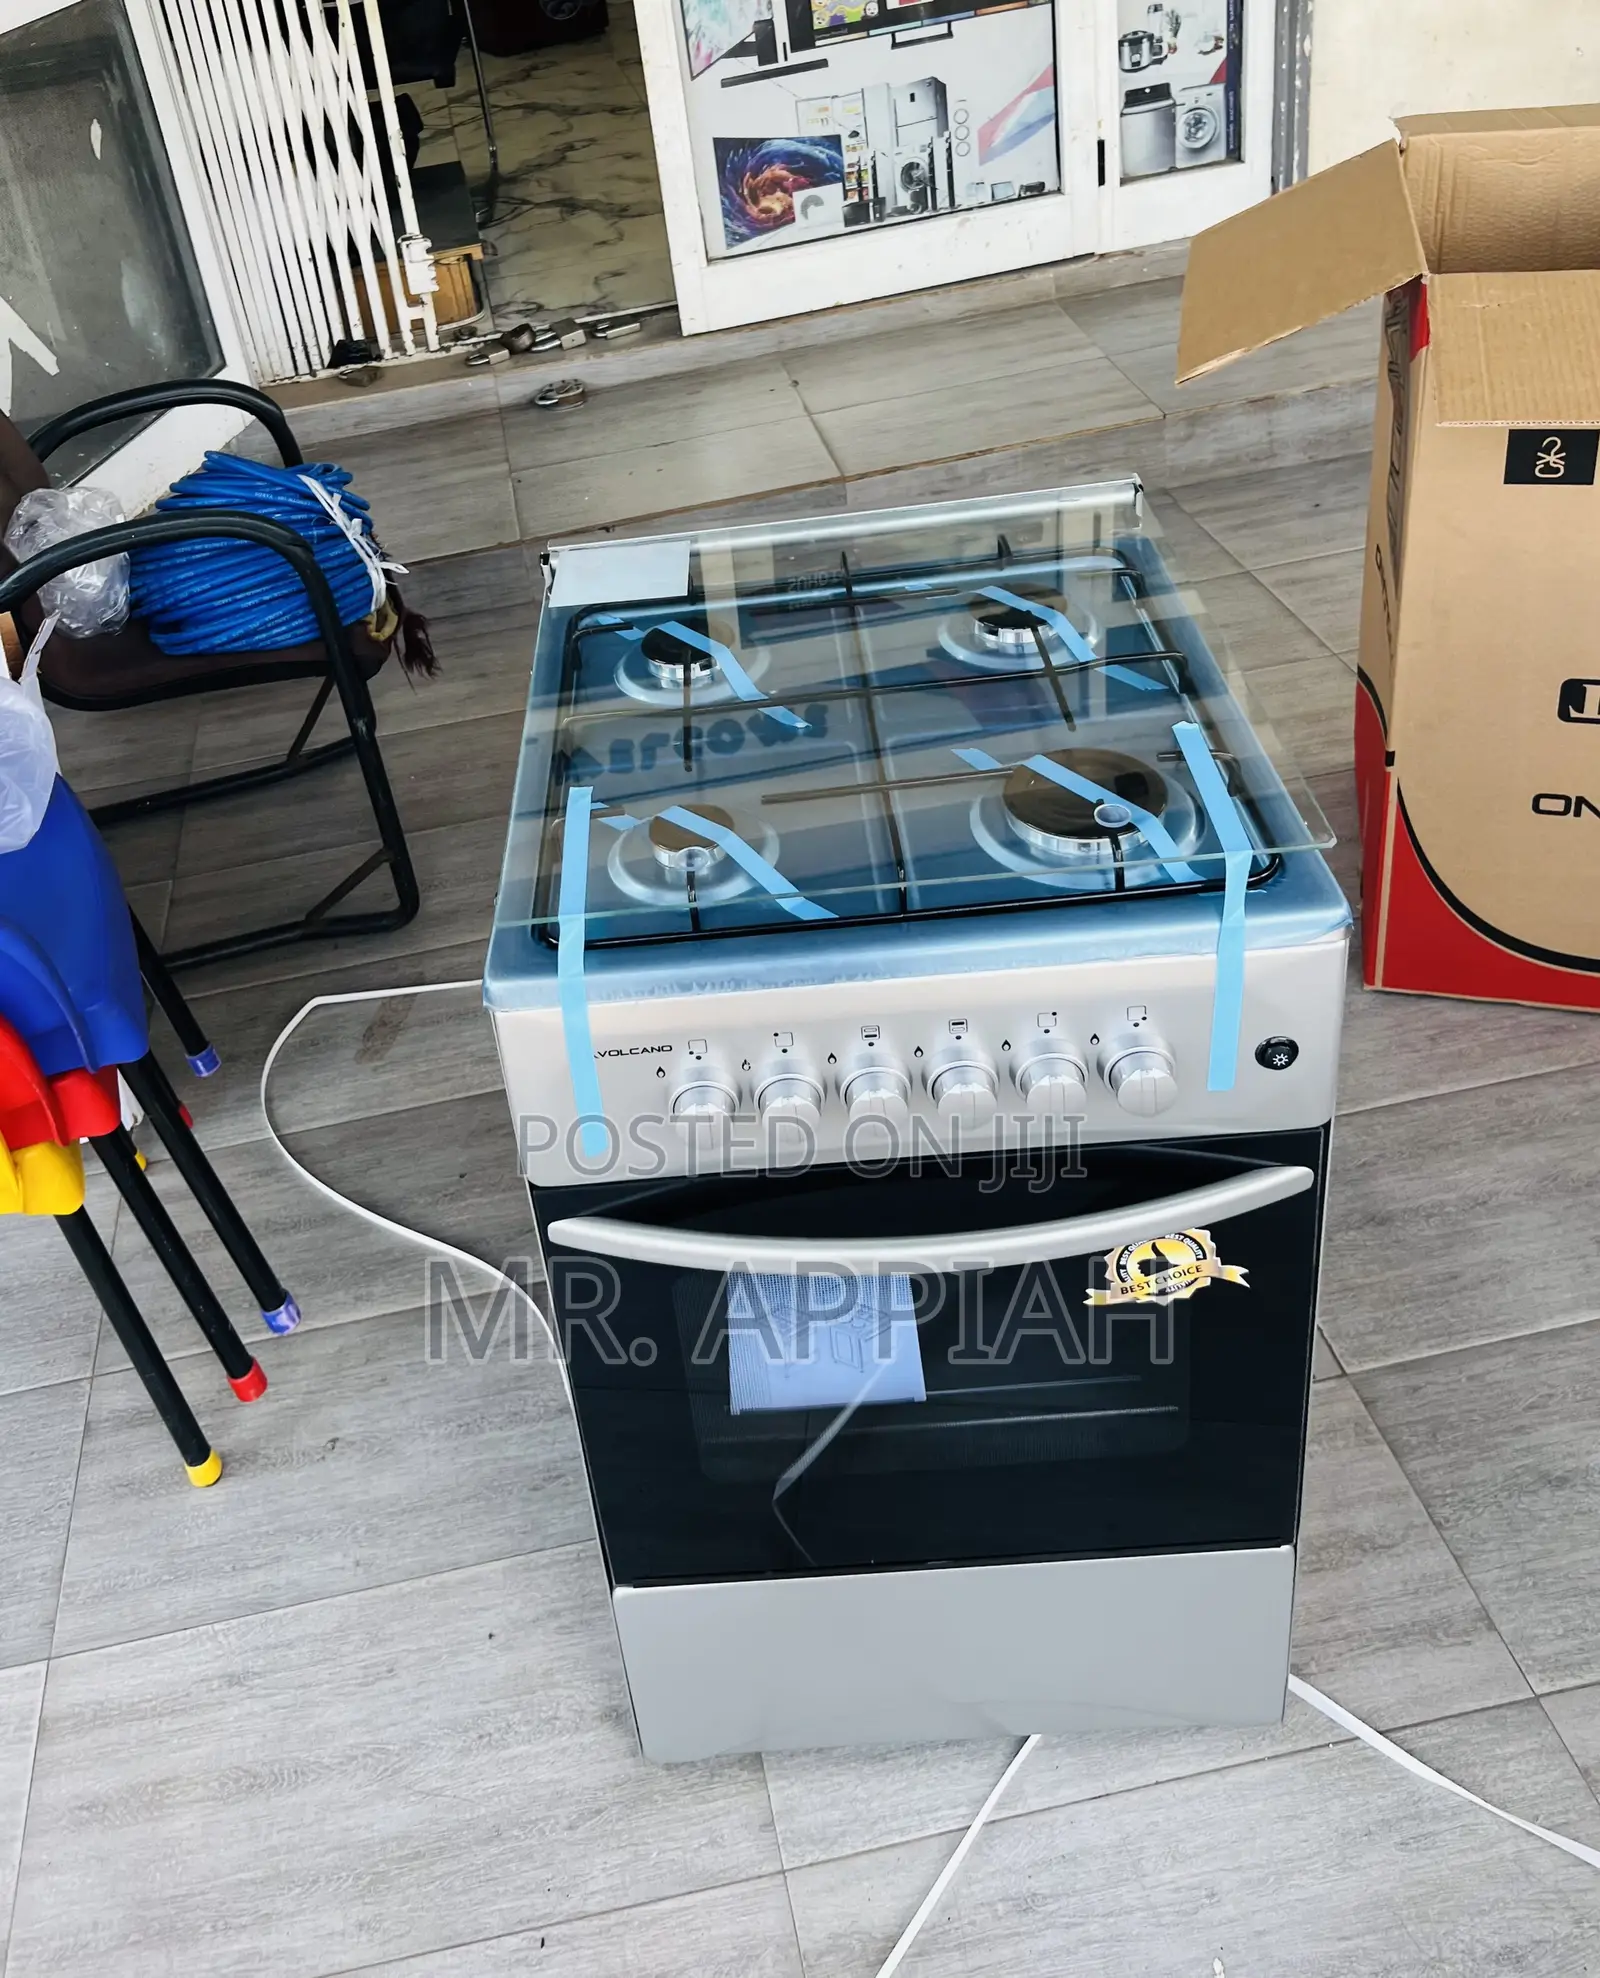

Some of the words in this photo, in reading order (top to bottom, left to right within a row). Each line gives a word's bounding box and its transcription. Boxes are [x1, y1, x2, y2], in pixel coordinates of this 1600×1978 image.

[597, 1044, 673, 1058] VOLCANO
[1119, 1249, 1131, 1265] BEST
[1183, 1237, 1204, 1259] QUALITY
[1120, 1280, 1152, 1295] BEST
[1155, 1264, 1204, 1285] CHOICE
